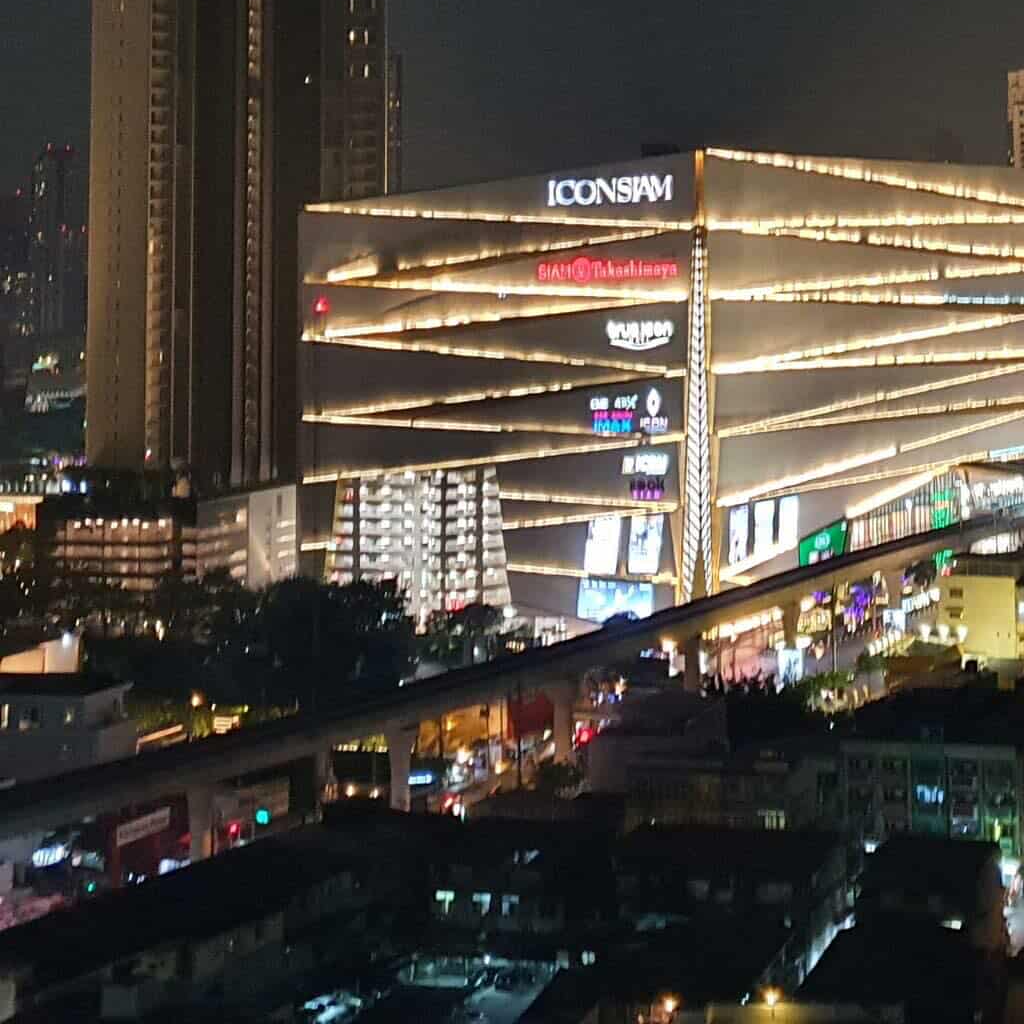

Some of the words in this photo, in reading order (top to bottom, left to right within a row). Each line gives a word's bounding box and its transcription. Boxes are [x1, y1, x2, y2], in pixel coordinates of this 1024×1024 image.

[547, 175, 673, 206] ICONSIAM
[538, 262, 572, 281] SIAM
[591, 259, 677, 280] Takashimaya
